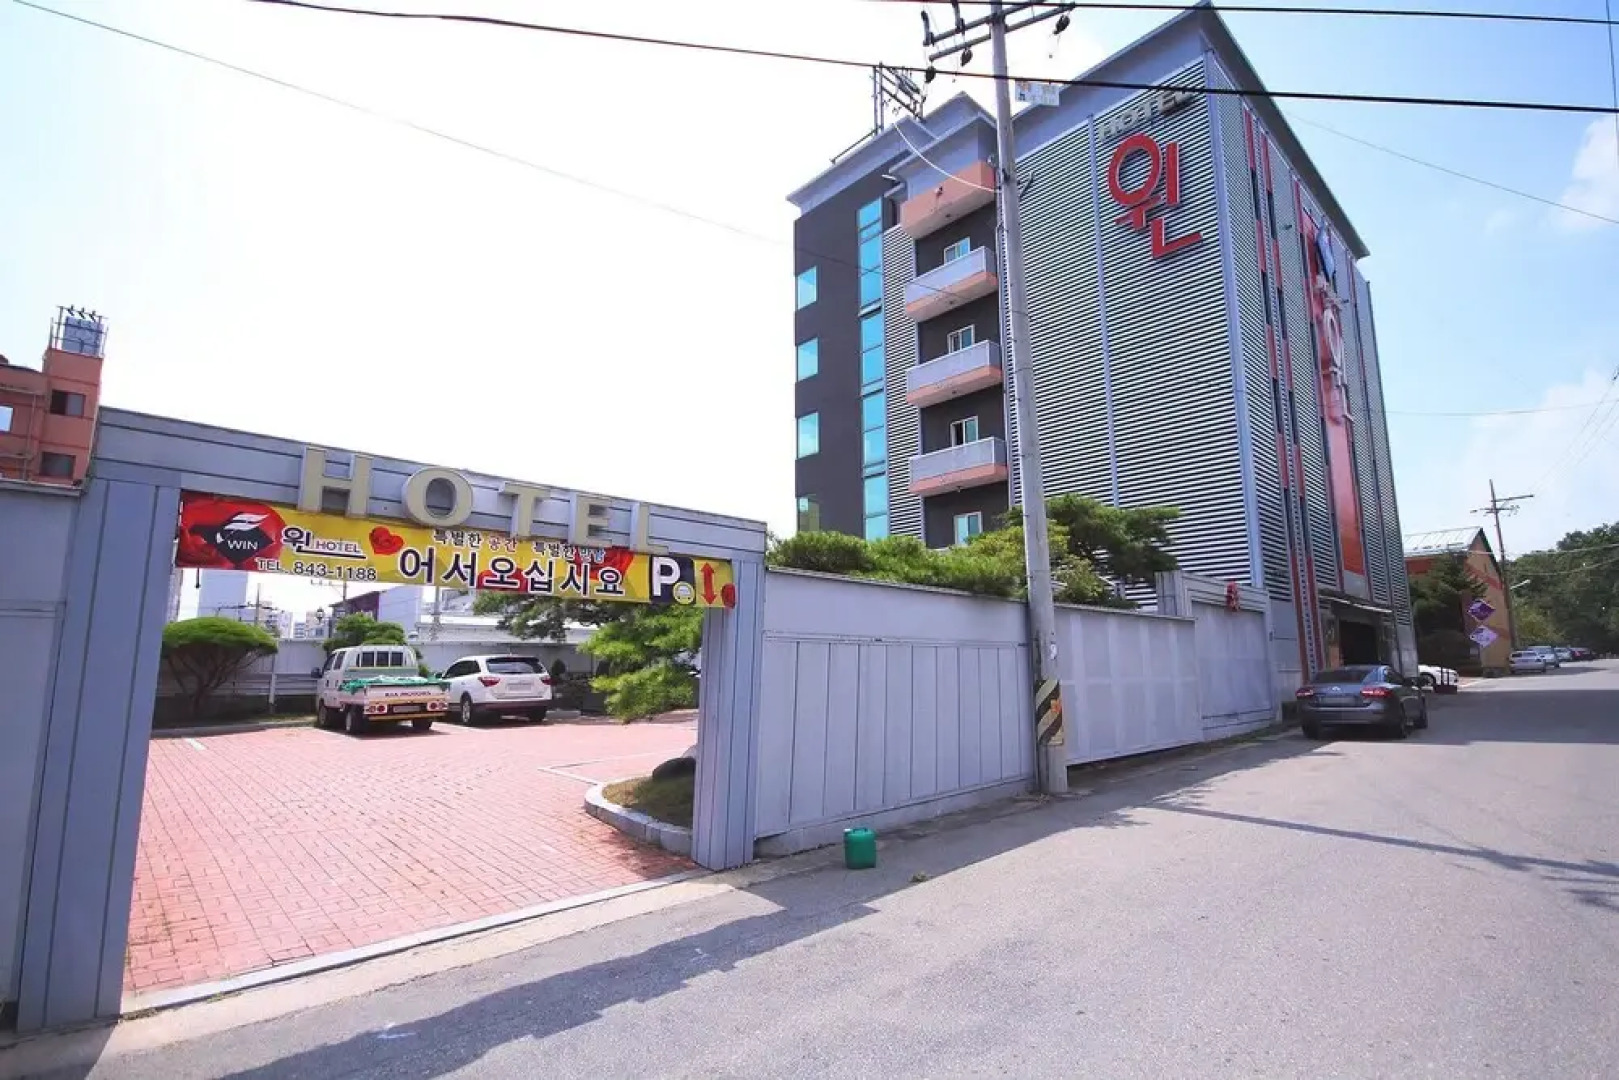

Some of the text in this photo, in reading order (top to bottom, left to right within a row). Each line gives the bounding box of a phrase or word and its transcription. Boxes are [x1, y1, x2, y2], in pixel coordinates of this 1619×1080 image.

[1107, 132, 1203, 260] 윈
[297, 446, 669, 554] HOTEL
[227, 540, 258, 550] WIN
[315, 540, 361, 554] HOTEL
[433, 528, 481, 548] 특별한
[294, 561, 377, 581] 843-1188
[401, 548, 624, 596] 어서오십시요
[652, 556, 680, 597] P
